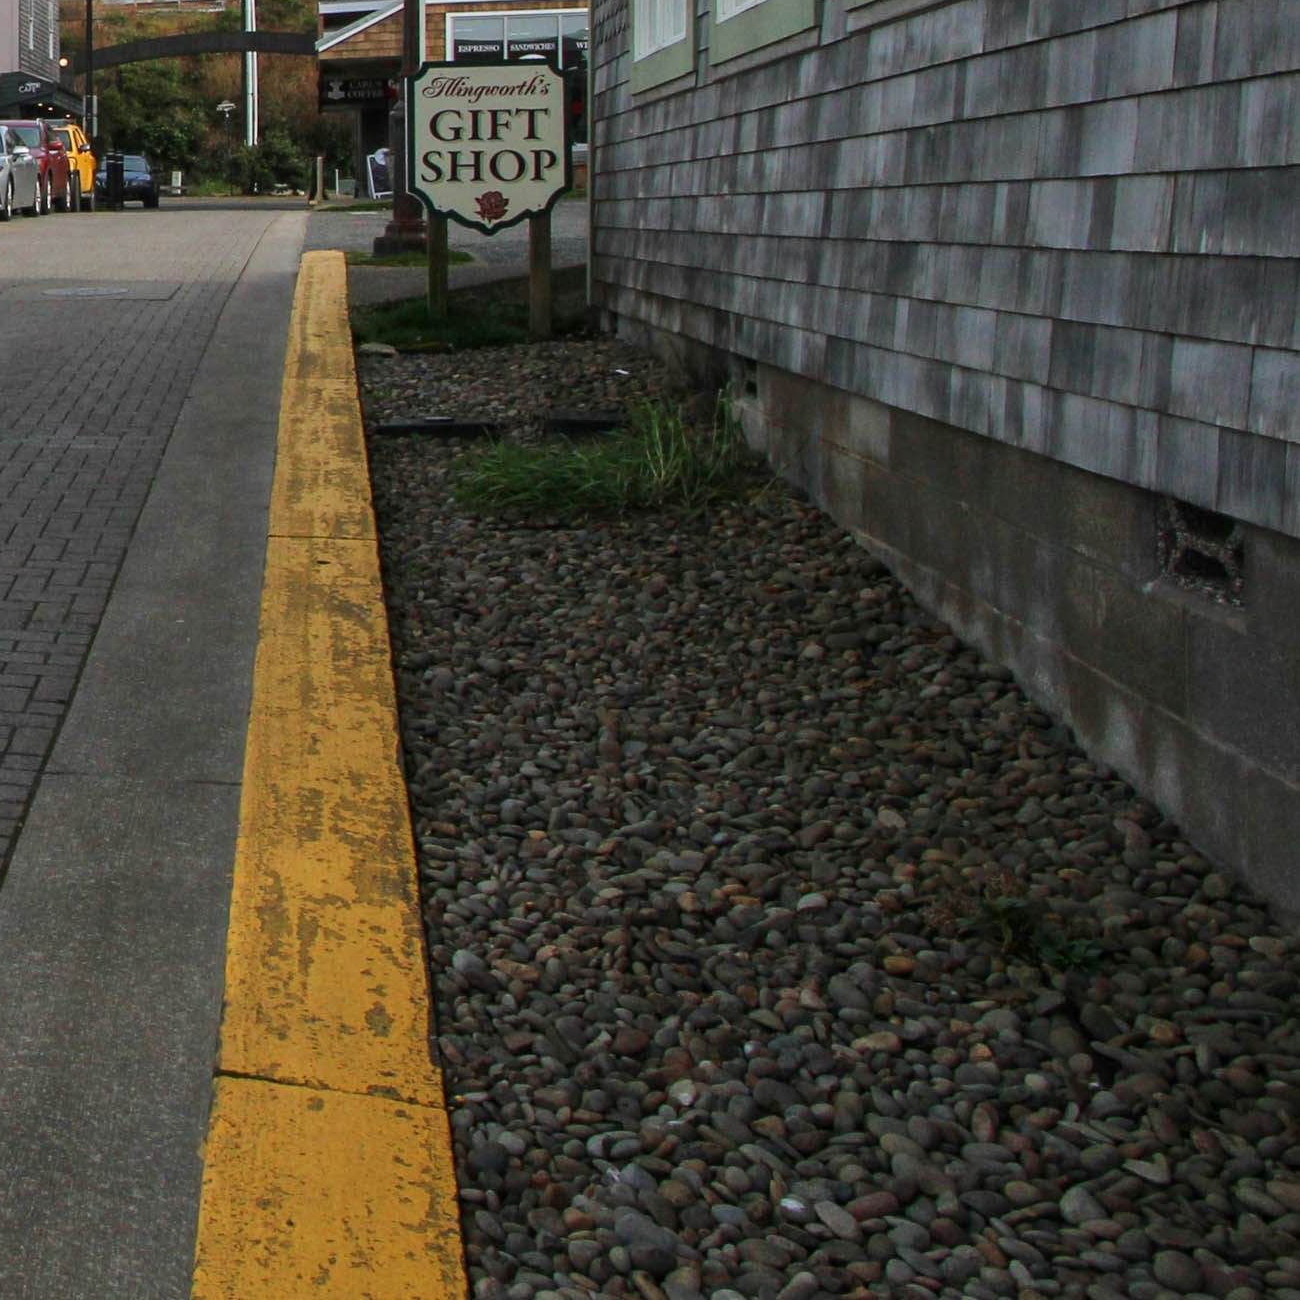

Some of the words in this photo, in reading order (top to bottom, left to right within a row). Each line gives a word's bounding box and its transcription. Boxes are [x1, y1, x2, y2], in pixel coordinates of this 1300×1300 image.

[458, 44, 500, 53] ESPRESSO
[510, 42, 556, 52] SANDWICHES
[429, 108, 550, 141] GIFT
[420, 149, 557, 183] SHOP
